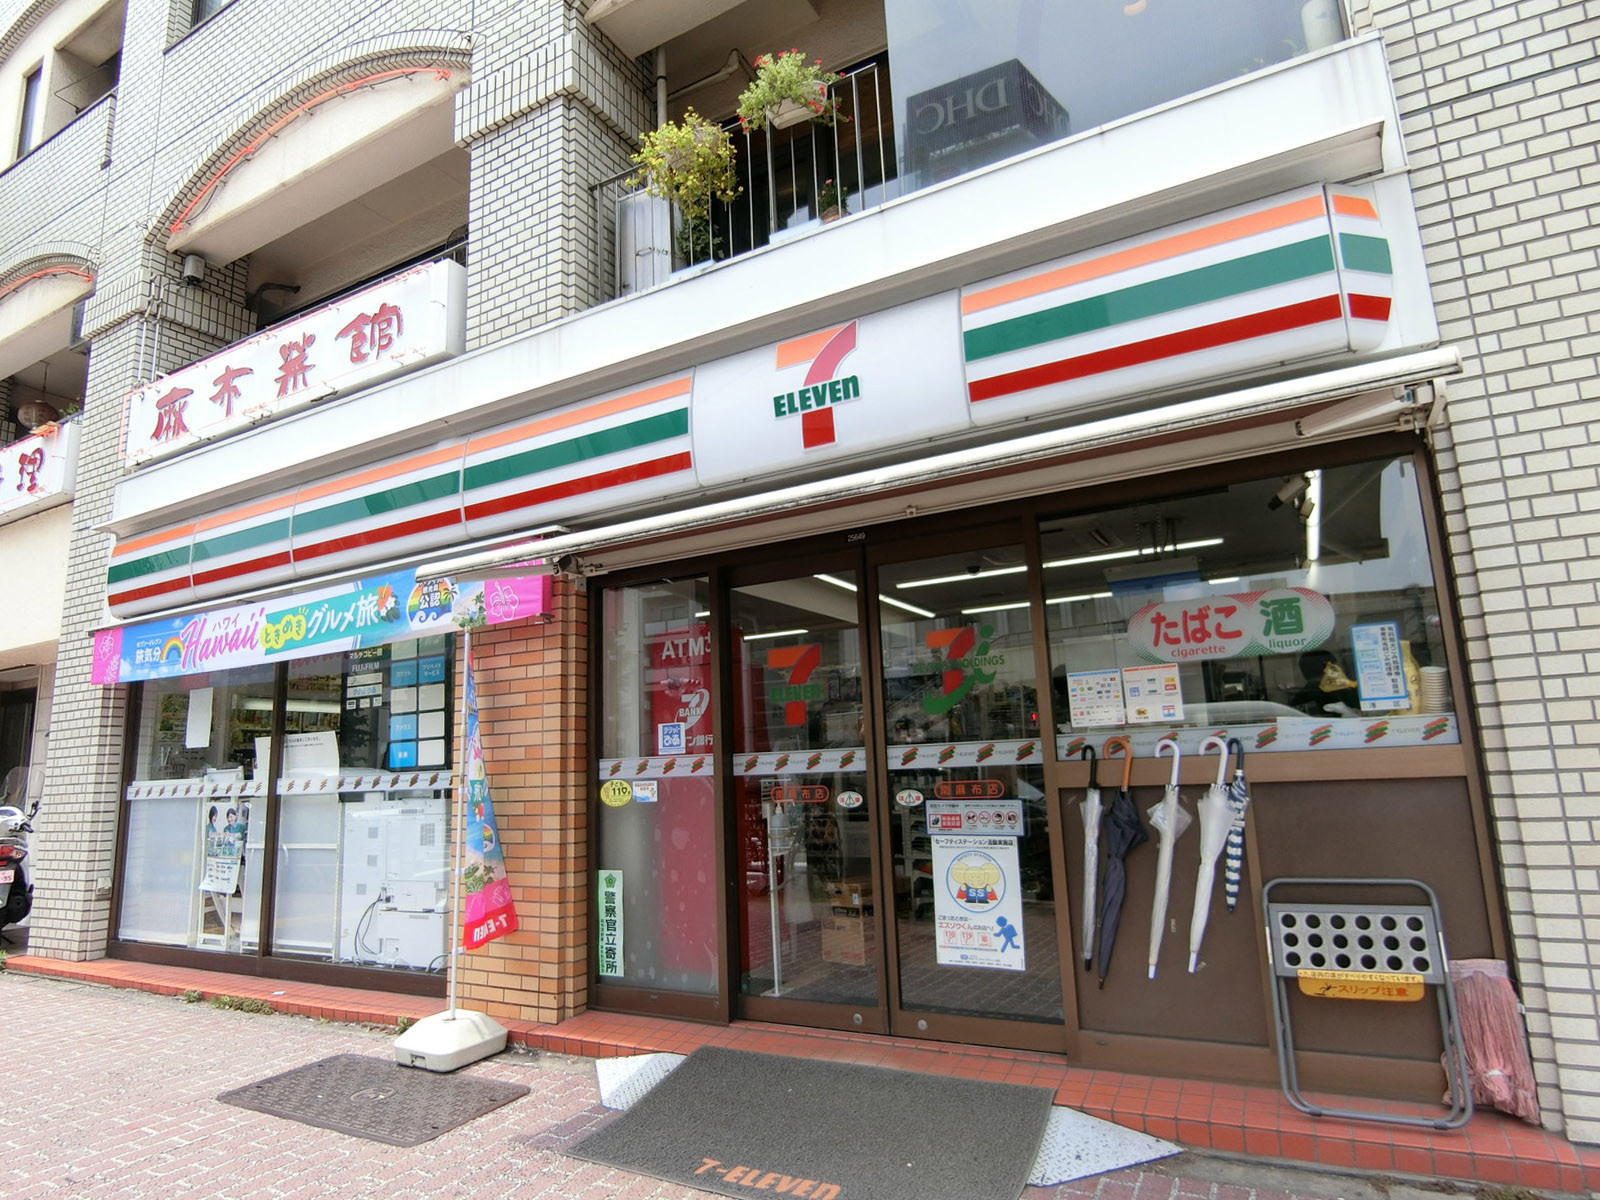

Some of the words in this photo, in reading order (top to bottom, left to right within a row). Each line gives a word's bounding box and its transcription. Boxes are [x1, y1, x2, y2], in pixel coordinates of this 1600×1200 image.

[420, 592, 440, 609] 公認
[212, 613, 239, 632] ハワイ
[1259, 597, 1304, 636] 酒
[1151, 605, 1243, 647] たばこ
[1268, 637, 1307, 650] liquor
[1171, 645, 1225, 658] cigarette
[678, 707, 703, 717] BANK
[969, 888, 985, 897] SS
[604, 891, 618, 975] 警察官立寄所
[1338, 985, 1408, 997] スリップ注意
